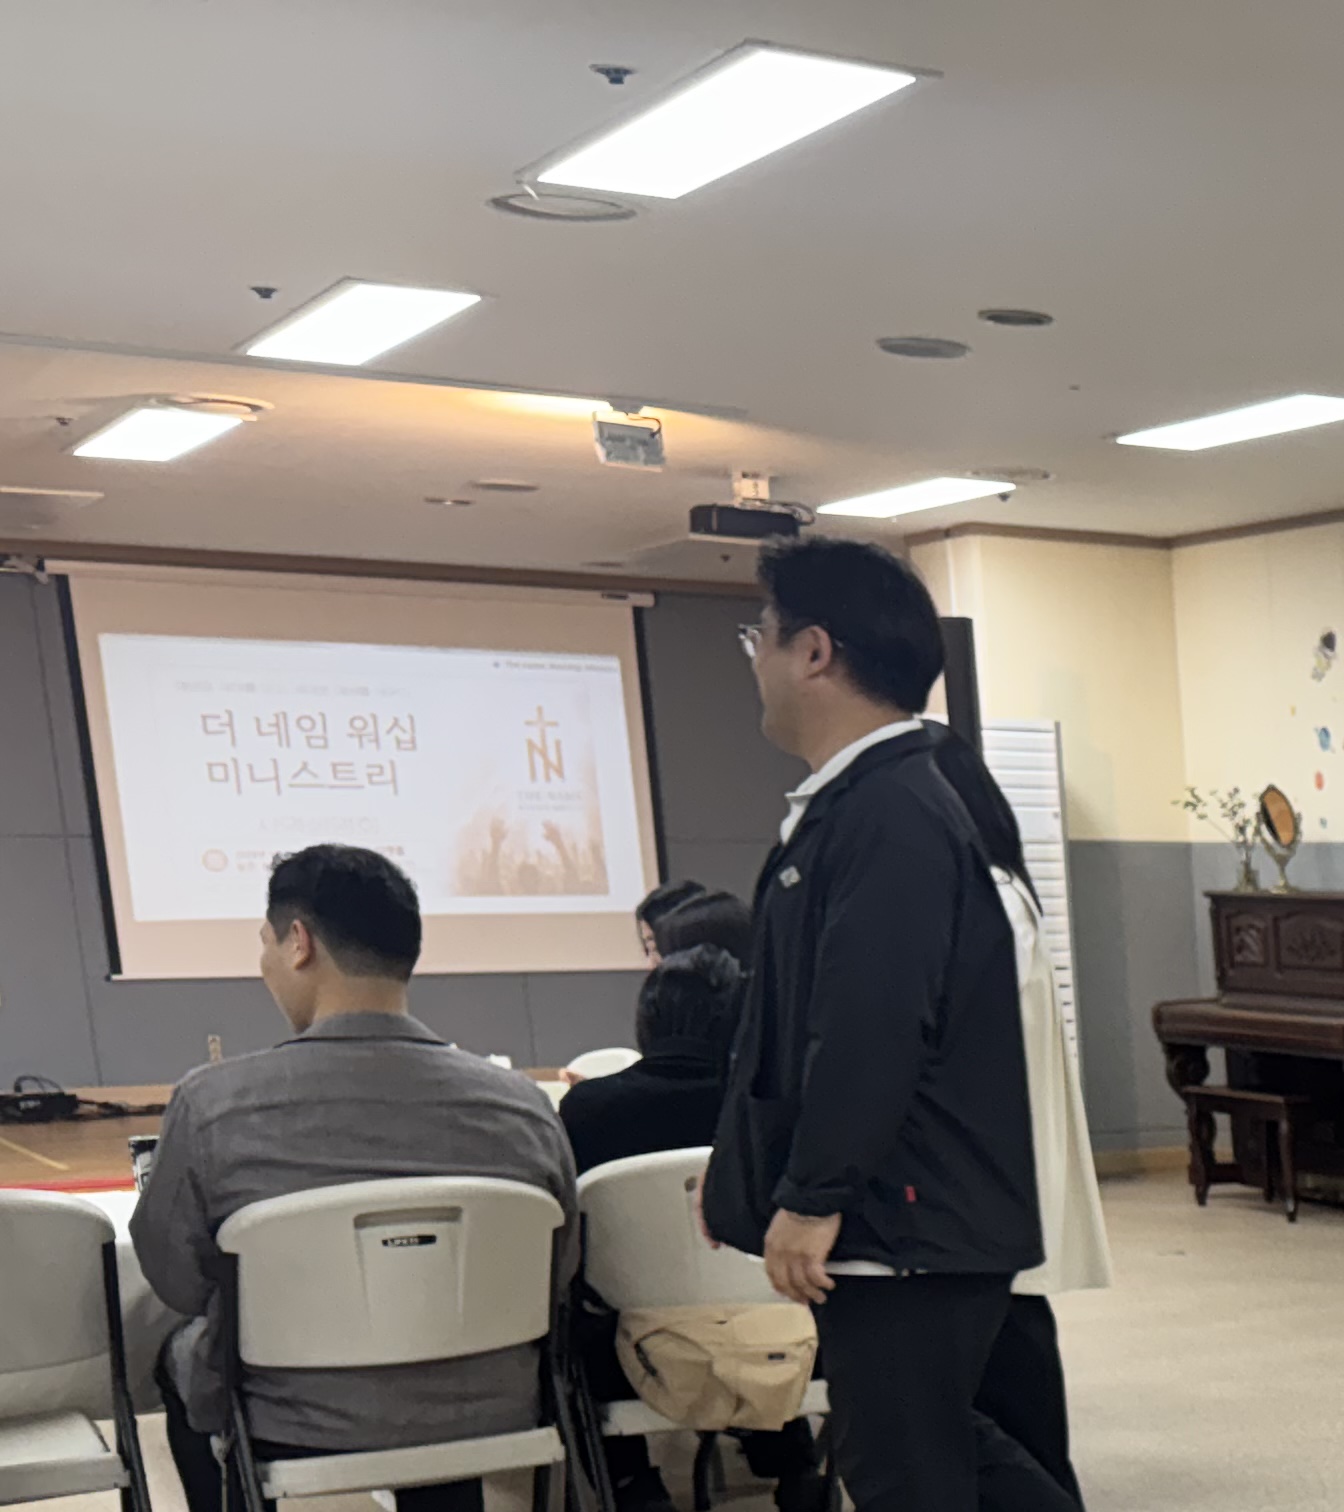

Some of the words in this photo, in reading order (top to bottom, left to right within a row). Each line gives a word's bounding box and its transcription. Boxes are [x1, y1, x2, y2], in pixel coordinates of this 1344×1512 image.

[200, 708, 237, 749] 더
[254, 710, 330, 750] 네임
[346, 711, 418, 753] 워십
[206, 756, 399, 797] 미니스트리
